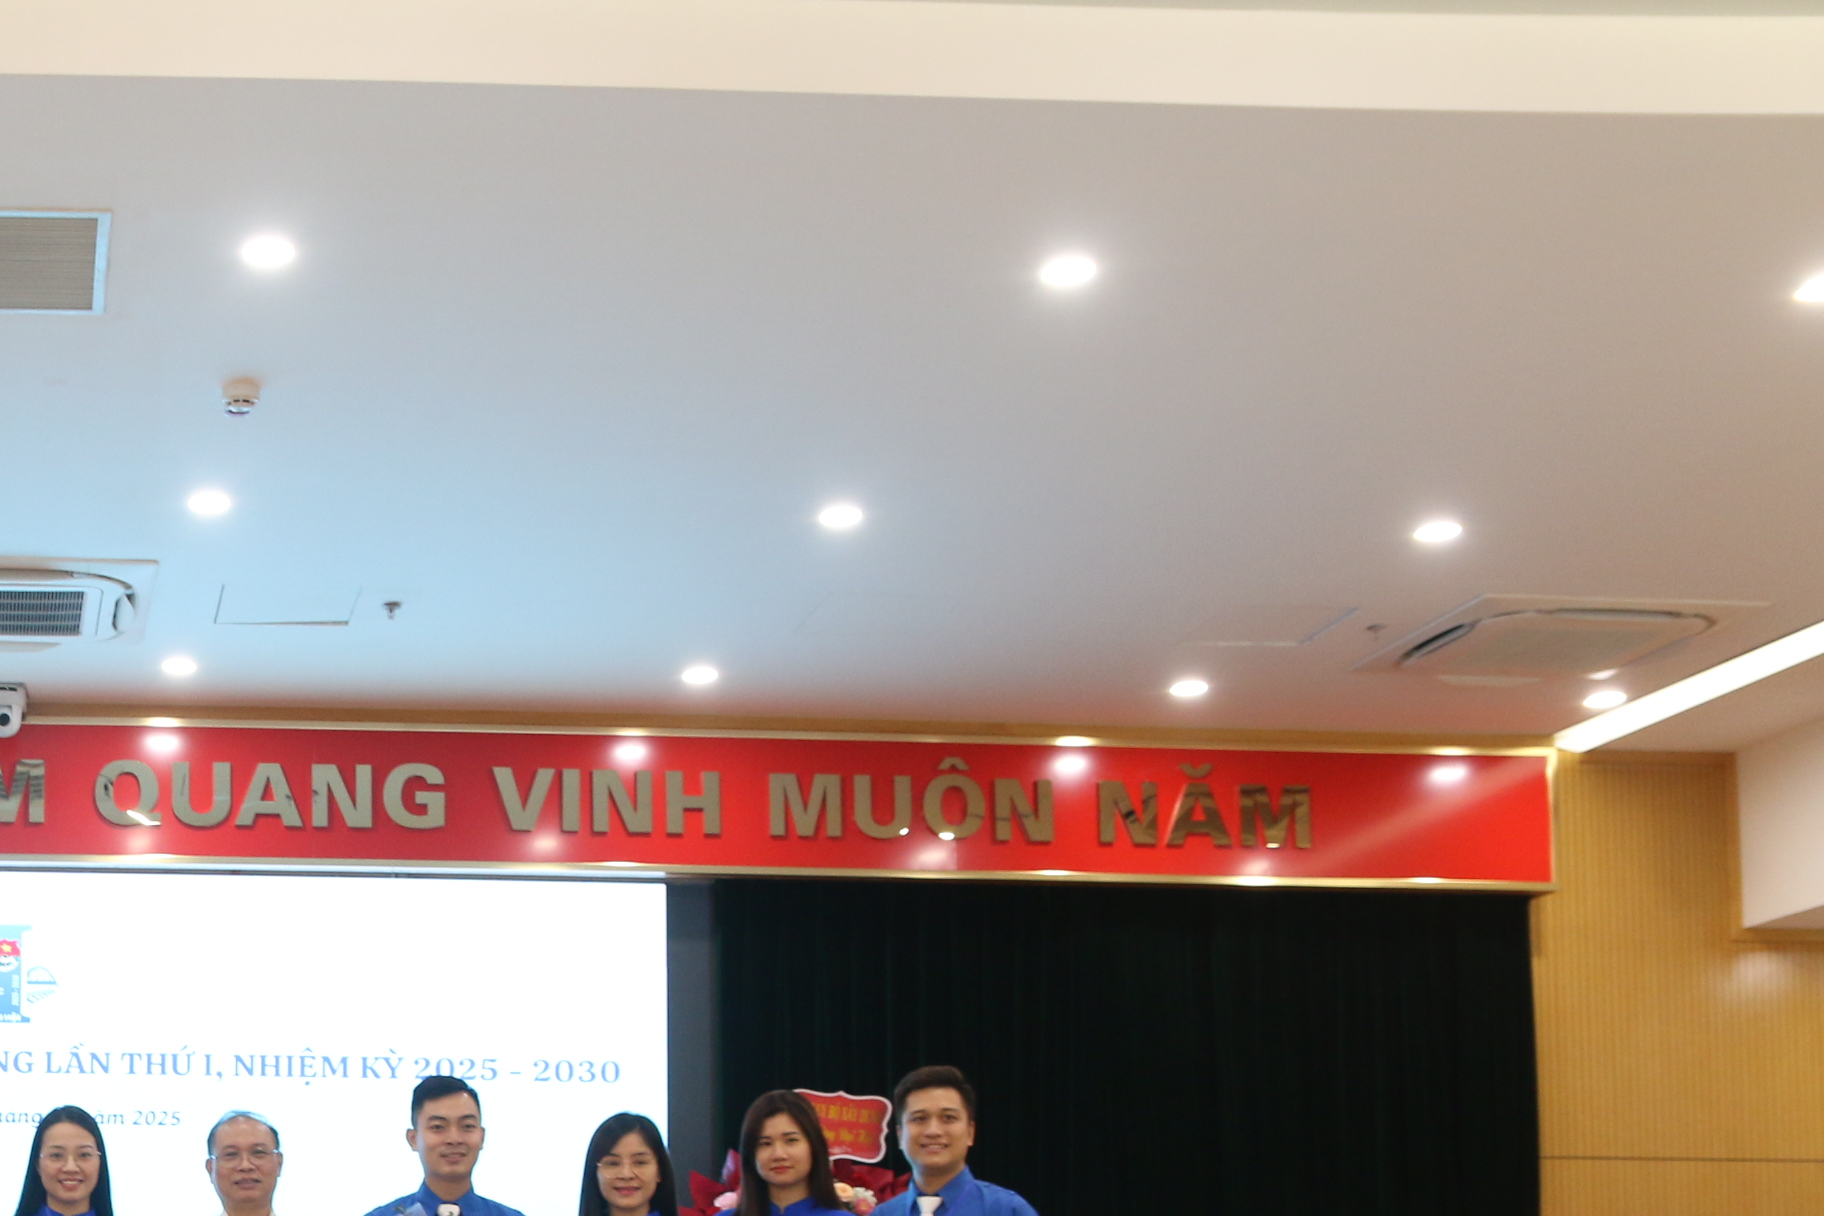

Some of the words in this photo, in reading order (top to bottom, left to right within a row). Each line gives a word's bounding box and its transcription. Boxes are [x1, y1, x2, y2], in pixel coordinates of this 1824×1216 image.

[94, 760, 446, 830] QUANG
[491, 766, 722, 836] VINH
[768, 758, 1054, 844] MUÔN
[1097, 762, 1314, 850] NĂM
[45, 1043, 111, 1074] LẦN
[121, 1045, 195, 1076] THỨ
[204, 1054, 223, 1081] I,
[233, 1048, 349, 1086] NHIỆM
[361, 1048, 404, 1079] KỲ
[413, 1057, 498, 1082] 2025
[533, 1059, 621, 1083] 2030
[95, 1110, 124, 1125] ăm
[132, 1110, 181, 1126] 2025
